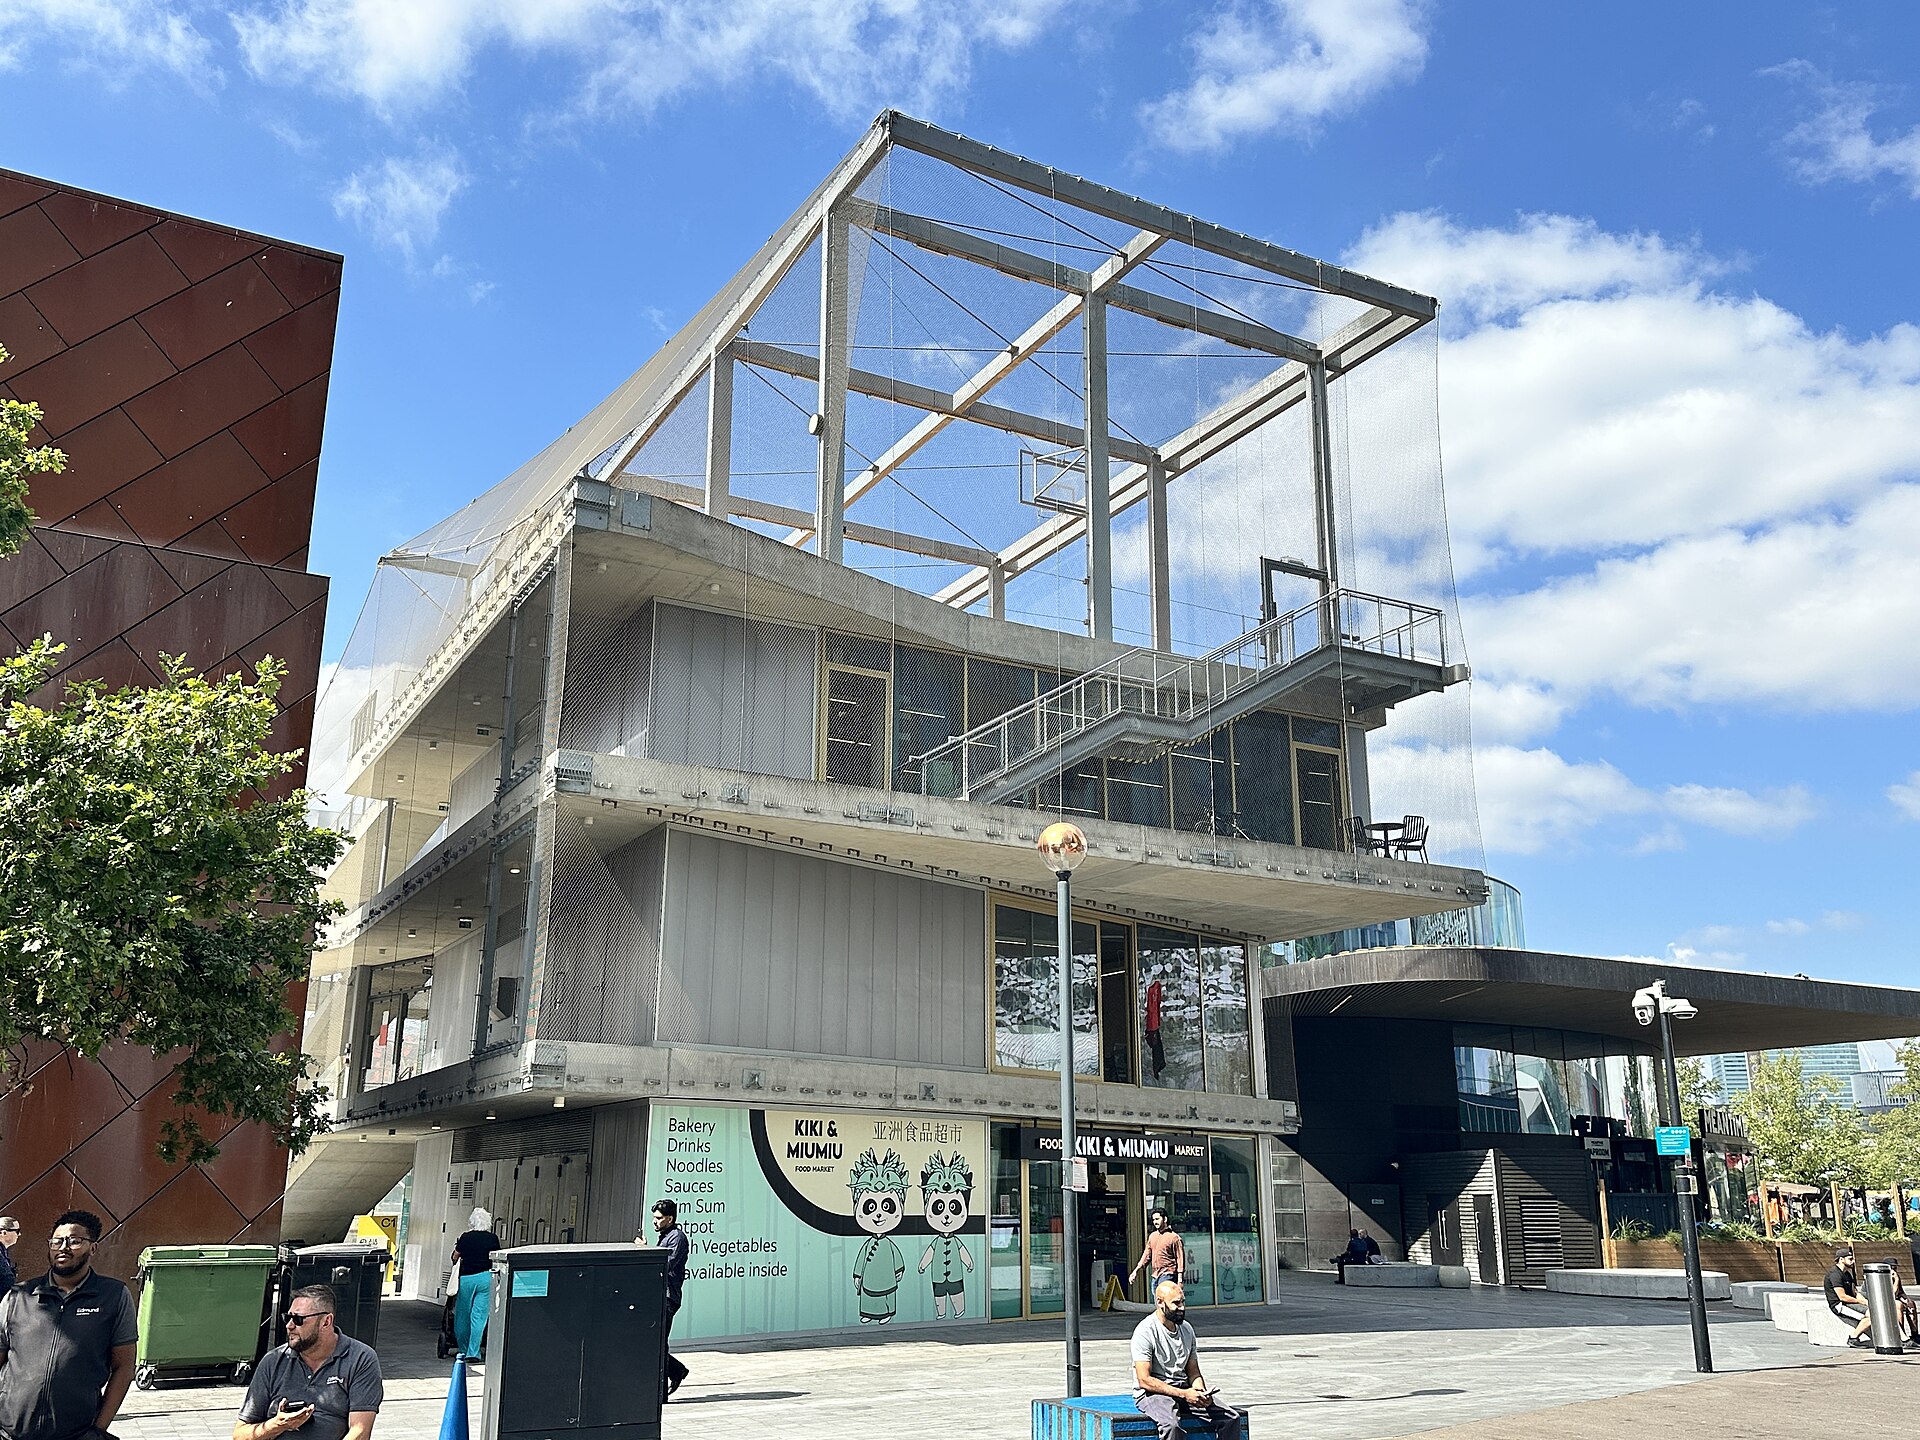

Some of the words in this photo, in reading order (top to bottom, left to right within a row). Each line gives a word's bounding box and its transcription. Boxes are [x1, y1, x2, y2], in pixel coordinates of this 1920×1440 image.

[668, 1117, 716, 1137] Bakery
[794, 1119, 823, 1137] KIKI
[826, 1120, 838, 1138] &
[872, 1120, 963, 1145] 亚洲食品超市
[667, 1137, 711, 1153] Drinks
[786, 1141, 843, 1160] MIUMIU
[1039, 1137, 1063, 1150] FOOD
[1103, 1136, 1116, 1157] &
[1118, 1137, 1169, 1159] MIUMIU
[1174, 1144, 1205, 1157] MARKET
[666, 1157, 723, 1173] Noodles
[795, 1165, 812, 1173] FOOD
[812, 1165, 835, 1173] MARKET
[664, 1178, 714, 1194] Sauces
[675, 1198, 691, 1213] im
[695, 1198, 726, 1214] Sum
[381, 1217, 396, 1228] C1
[675, 1219, 715, 1237] otpot
[702, 1237, 777, 1257] Vegetables
[684, 1262, 745, 1280] available
[749, 1261, 788, 1277] inside
